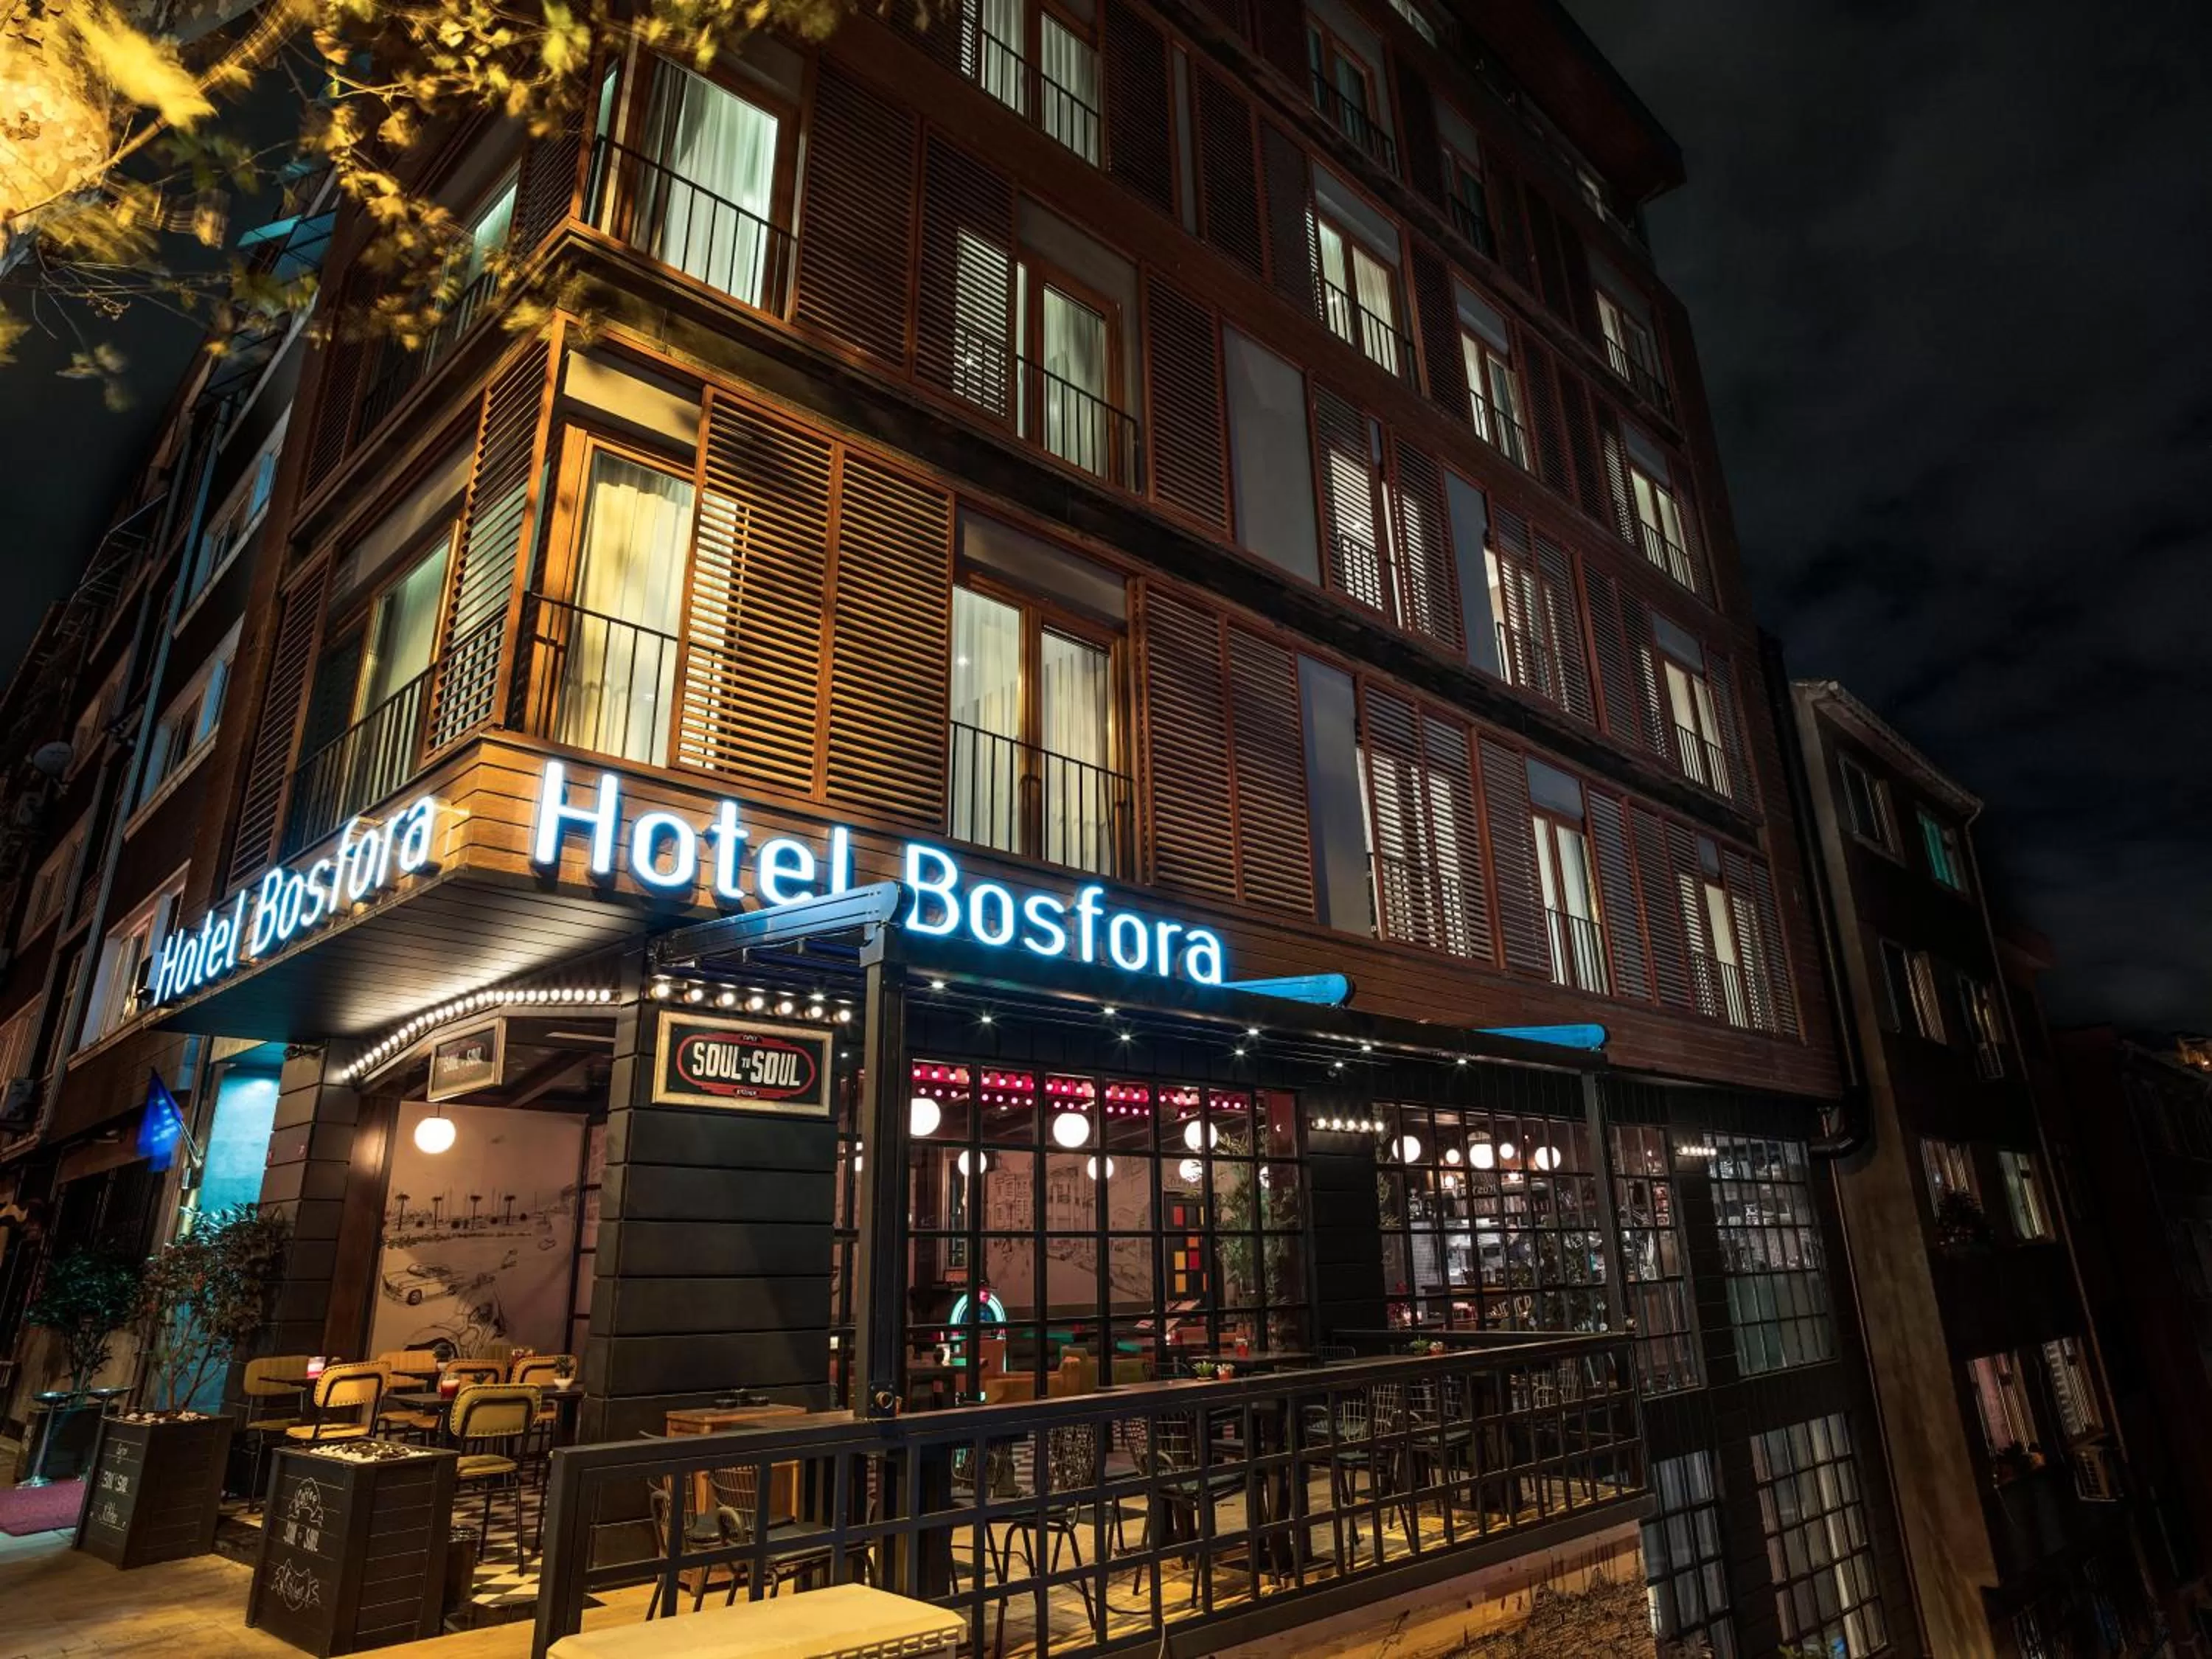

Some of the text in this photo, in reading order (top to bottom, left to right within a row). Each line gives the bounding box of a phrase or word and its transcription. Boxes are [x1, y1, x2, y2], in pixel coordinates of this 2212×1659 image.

[153, 796, 435, 1006] Hotel Bosfora
[535, 762, 1222, 984] Hotel Bosfora
[692, 1042, 742, 1080] SOUL
[750, 1050, 800, 1086] SOUL
